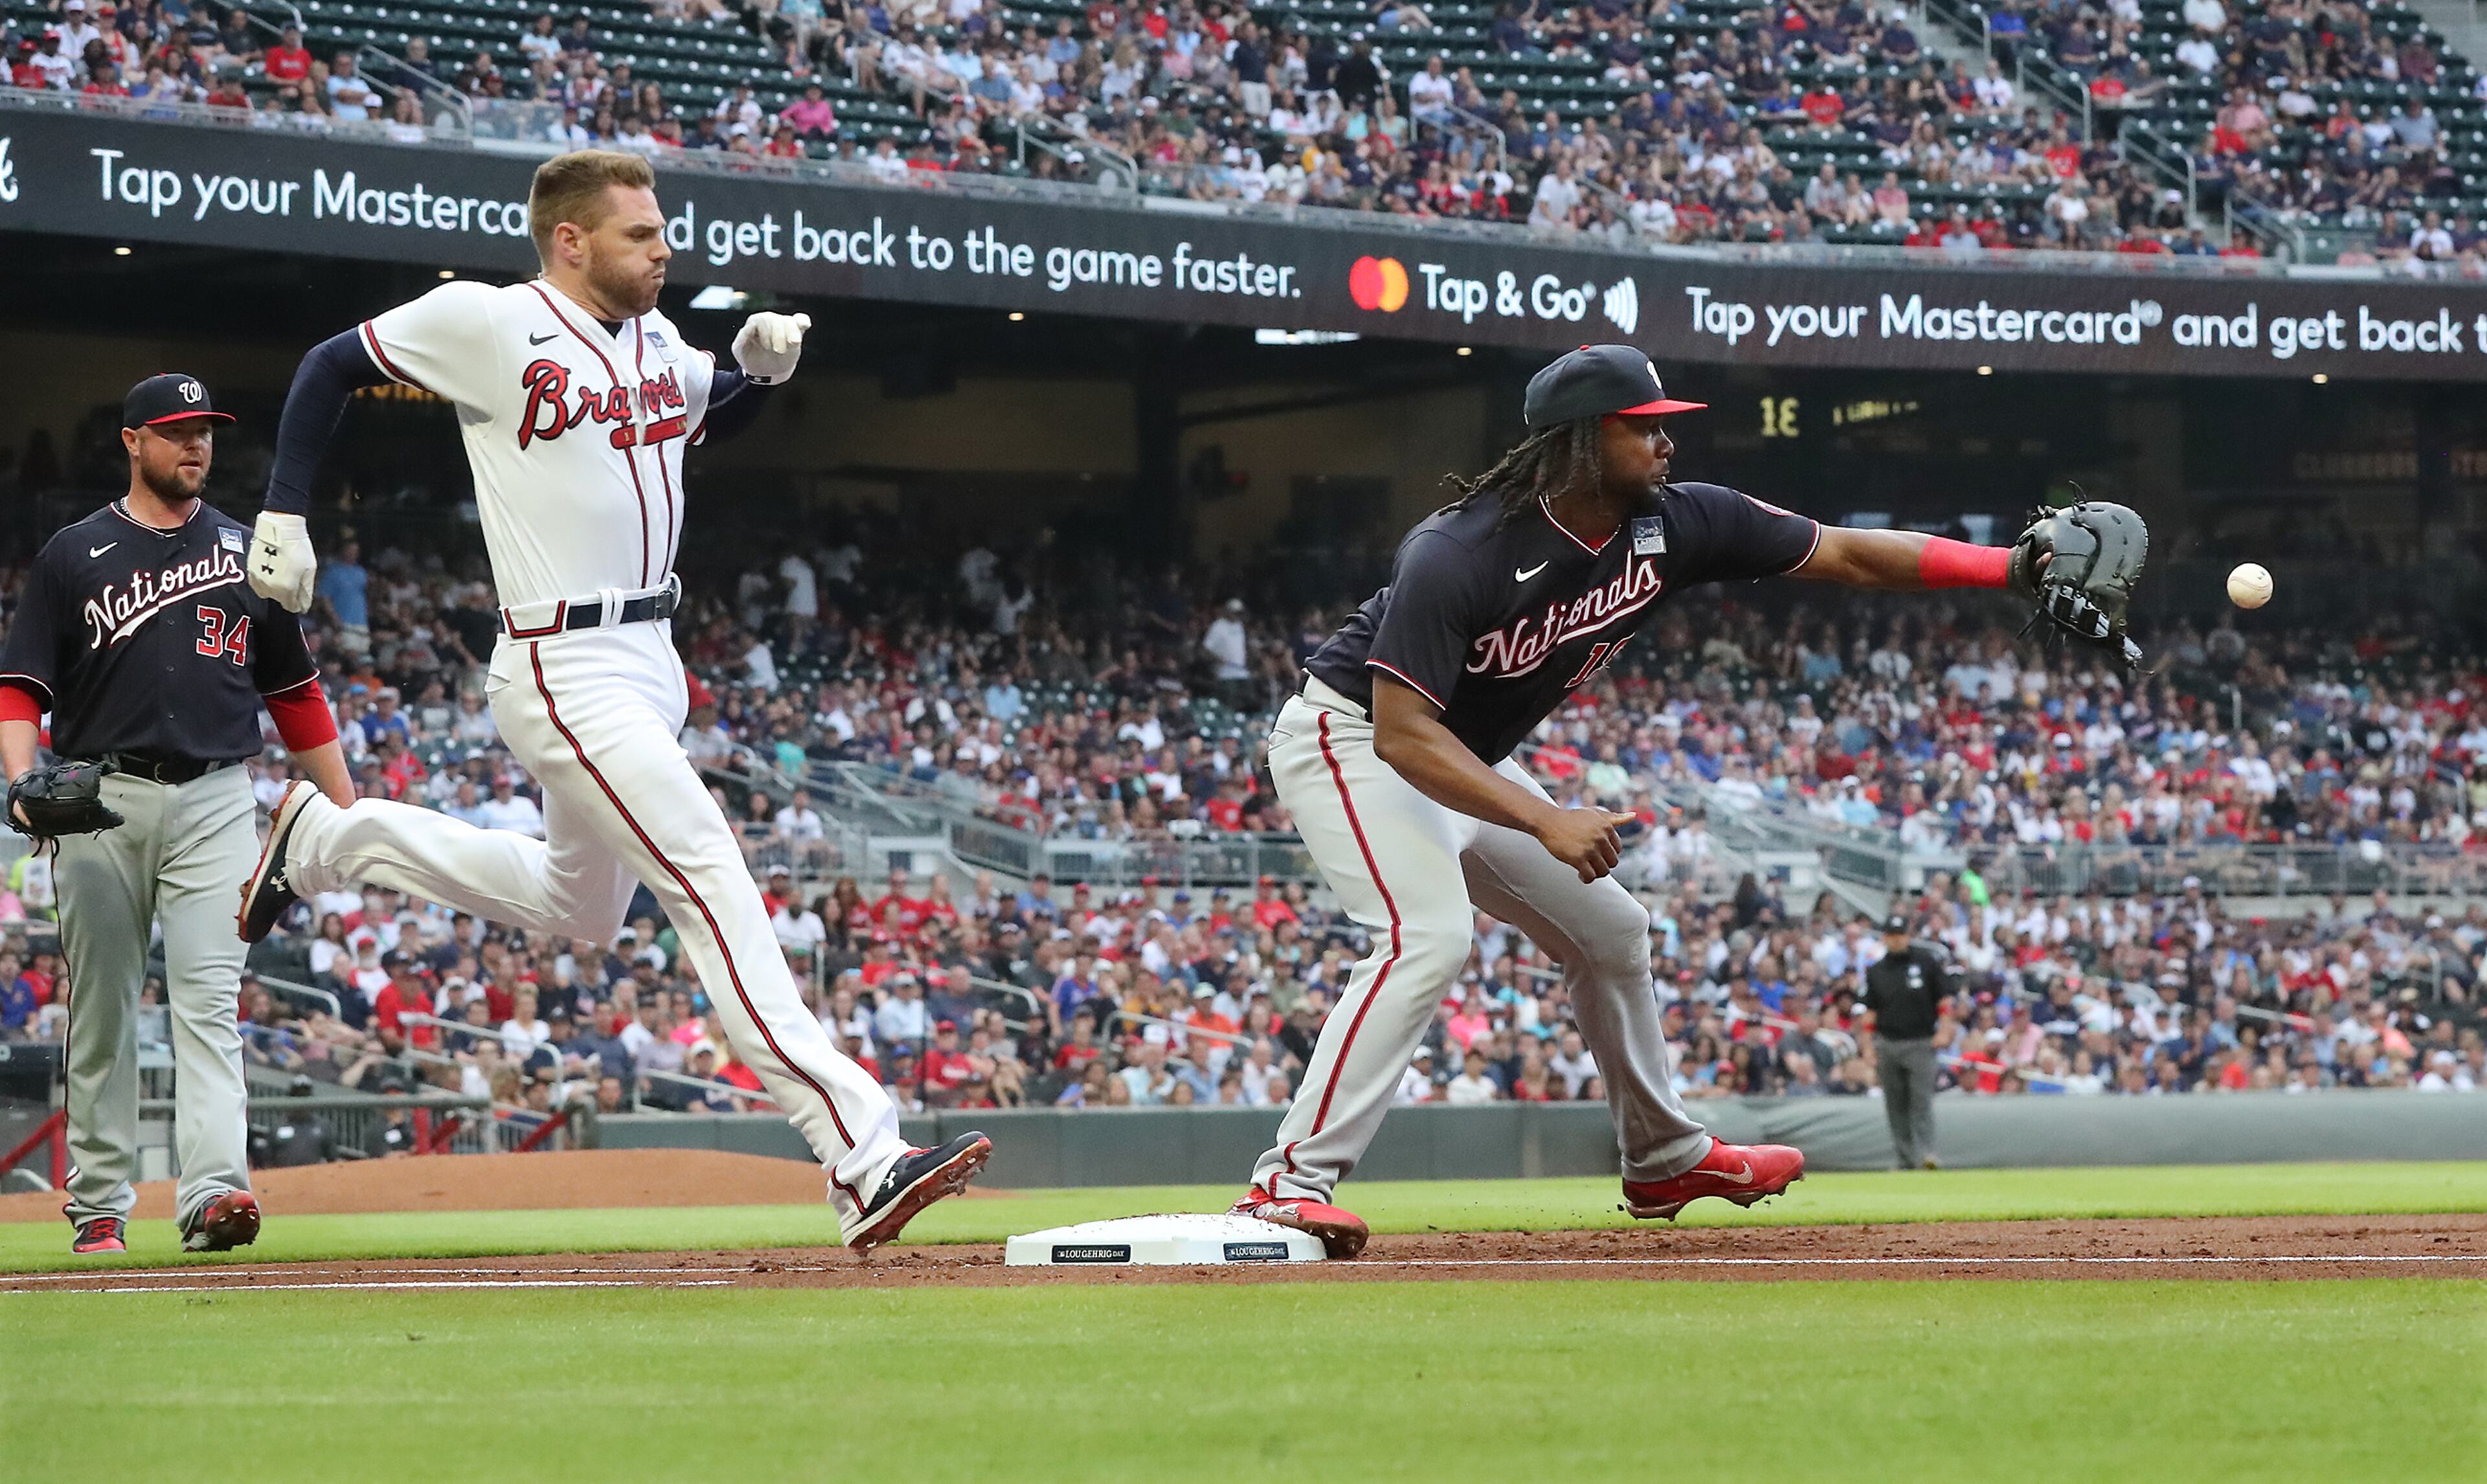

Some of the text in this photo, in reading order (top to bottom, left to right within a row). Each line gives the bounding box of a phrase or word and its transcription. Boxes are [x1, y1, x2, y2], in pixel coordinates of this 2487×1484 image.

[91, 148, 182, 218] Tap
[192, 173, 301, 221] your
[314, 168, 529, 237] Masterca
[706, 213, 782, 266] get
[794, 210, 896, 267] back
[907, 225, 953, 271] to
[964, 225, 1035, 276] the
[1046, 247, 1163, 291] game
[1172, 242, 1301, 298] faster.
[1418, 263, 1488, 324] Tap
[1495, 270, 1525, 317] &
[1685, 286, 1755, 346] Tap
[1765, 305, 1868, 347] your
[2172, 302, 2258, 348] and
[2269, 309, 2346, 359] get
[2359, 305, 2463, 353] back
[84, 543, 245, 650] Nationals
[1466, 549, 1662, 679] Nationals
[196, 604, 251, 666] 34
[1065, 1250, 1081, 1258] LOU
[1081, 1249, 1112, 1258] GEHRIG
[1236, 1247, 1249, 1255] LOU
